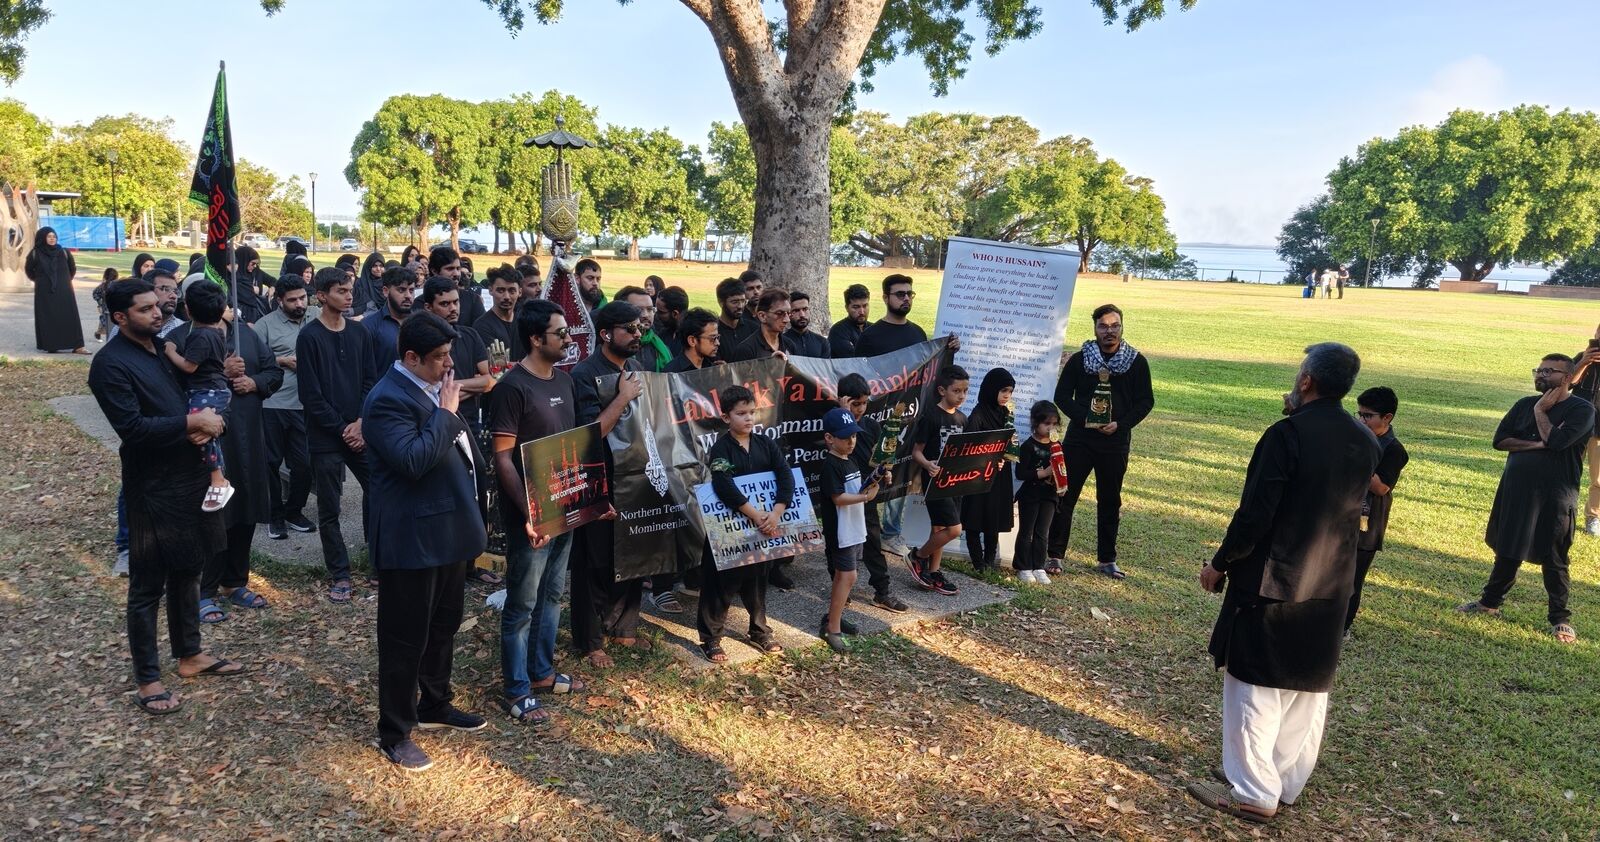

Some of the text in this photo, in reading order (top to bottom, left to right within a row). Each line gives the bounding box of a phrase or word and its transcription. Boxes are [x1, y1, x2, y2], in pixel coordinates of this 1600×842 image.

[972, 253, 993, 261] WHO
[1006, 257, 1046, 268] HUSSAIN?
[953, 273, 975, 281] cluding
[996, 268, 1026, 278] everything
[1032, 292, 1054, 300] around
[946, 302, 966, 310] inspire
[1000, 298, 1019, 306] legacy
[1020, 302, 1047, 310] continues
[982, 316, 997, 324] daily
[1028, 331, 1042, 339] family
[944, 439, 1010, 458] Ya Hussain!
[793, 447, 828, 464] Peac
[984, 461, 994, 481] يا
[551, 483, 588, 501] and compassion.
[755, 493, 766, 503] IS
[620, 507, 662, 520] Northern
[629, 521, 678, 536] Momineen
[722, 544, 750, 556] IMAM
[753, 530, 822, 551] HUSSAIN(A.S)
